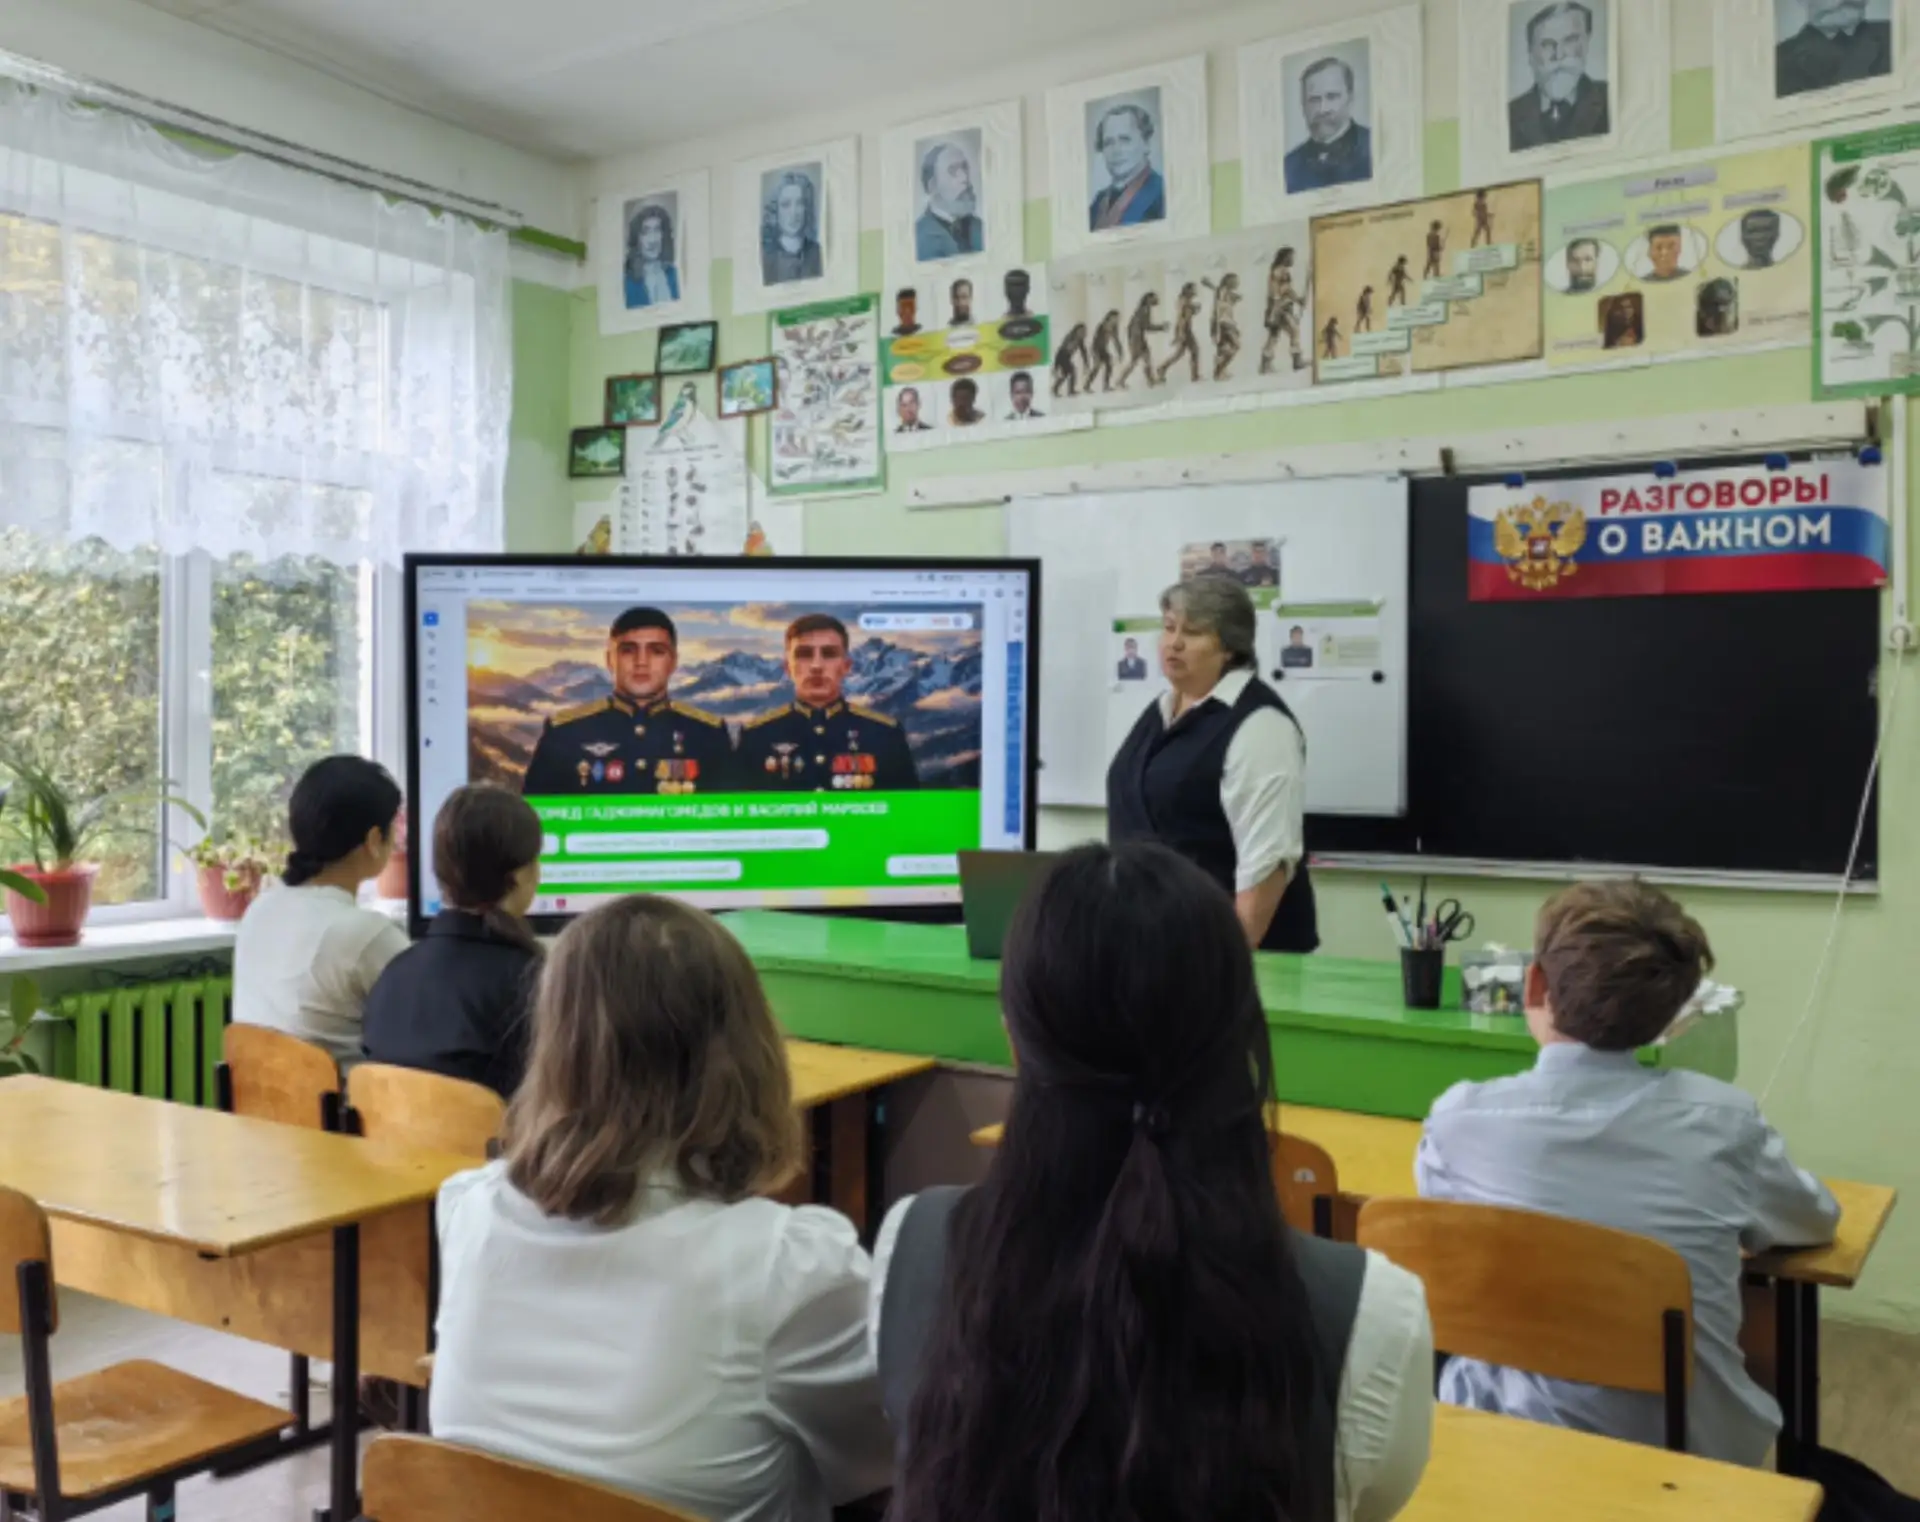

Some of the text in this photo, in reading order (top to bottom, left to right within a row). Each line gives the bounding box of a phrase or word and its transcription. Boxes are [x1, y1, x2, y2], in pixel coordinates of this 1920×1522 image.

[1600, 473, 1828, 515] РАЗГОВОРЫ
[1598, 512, 1832, 555] О ВАЖНОМ
